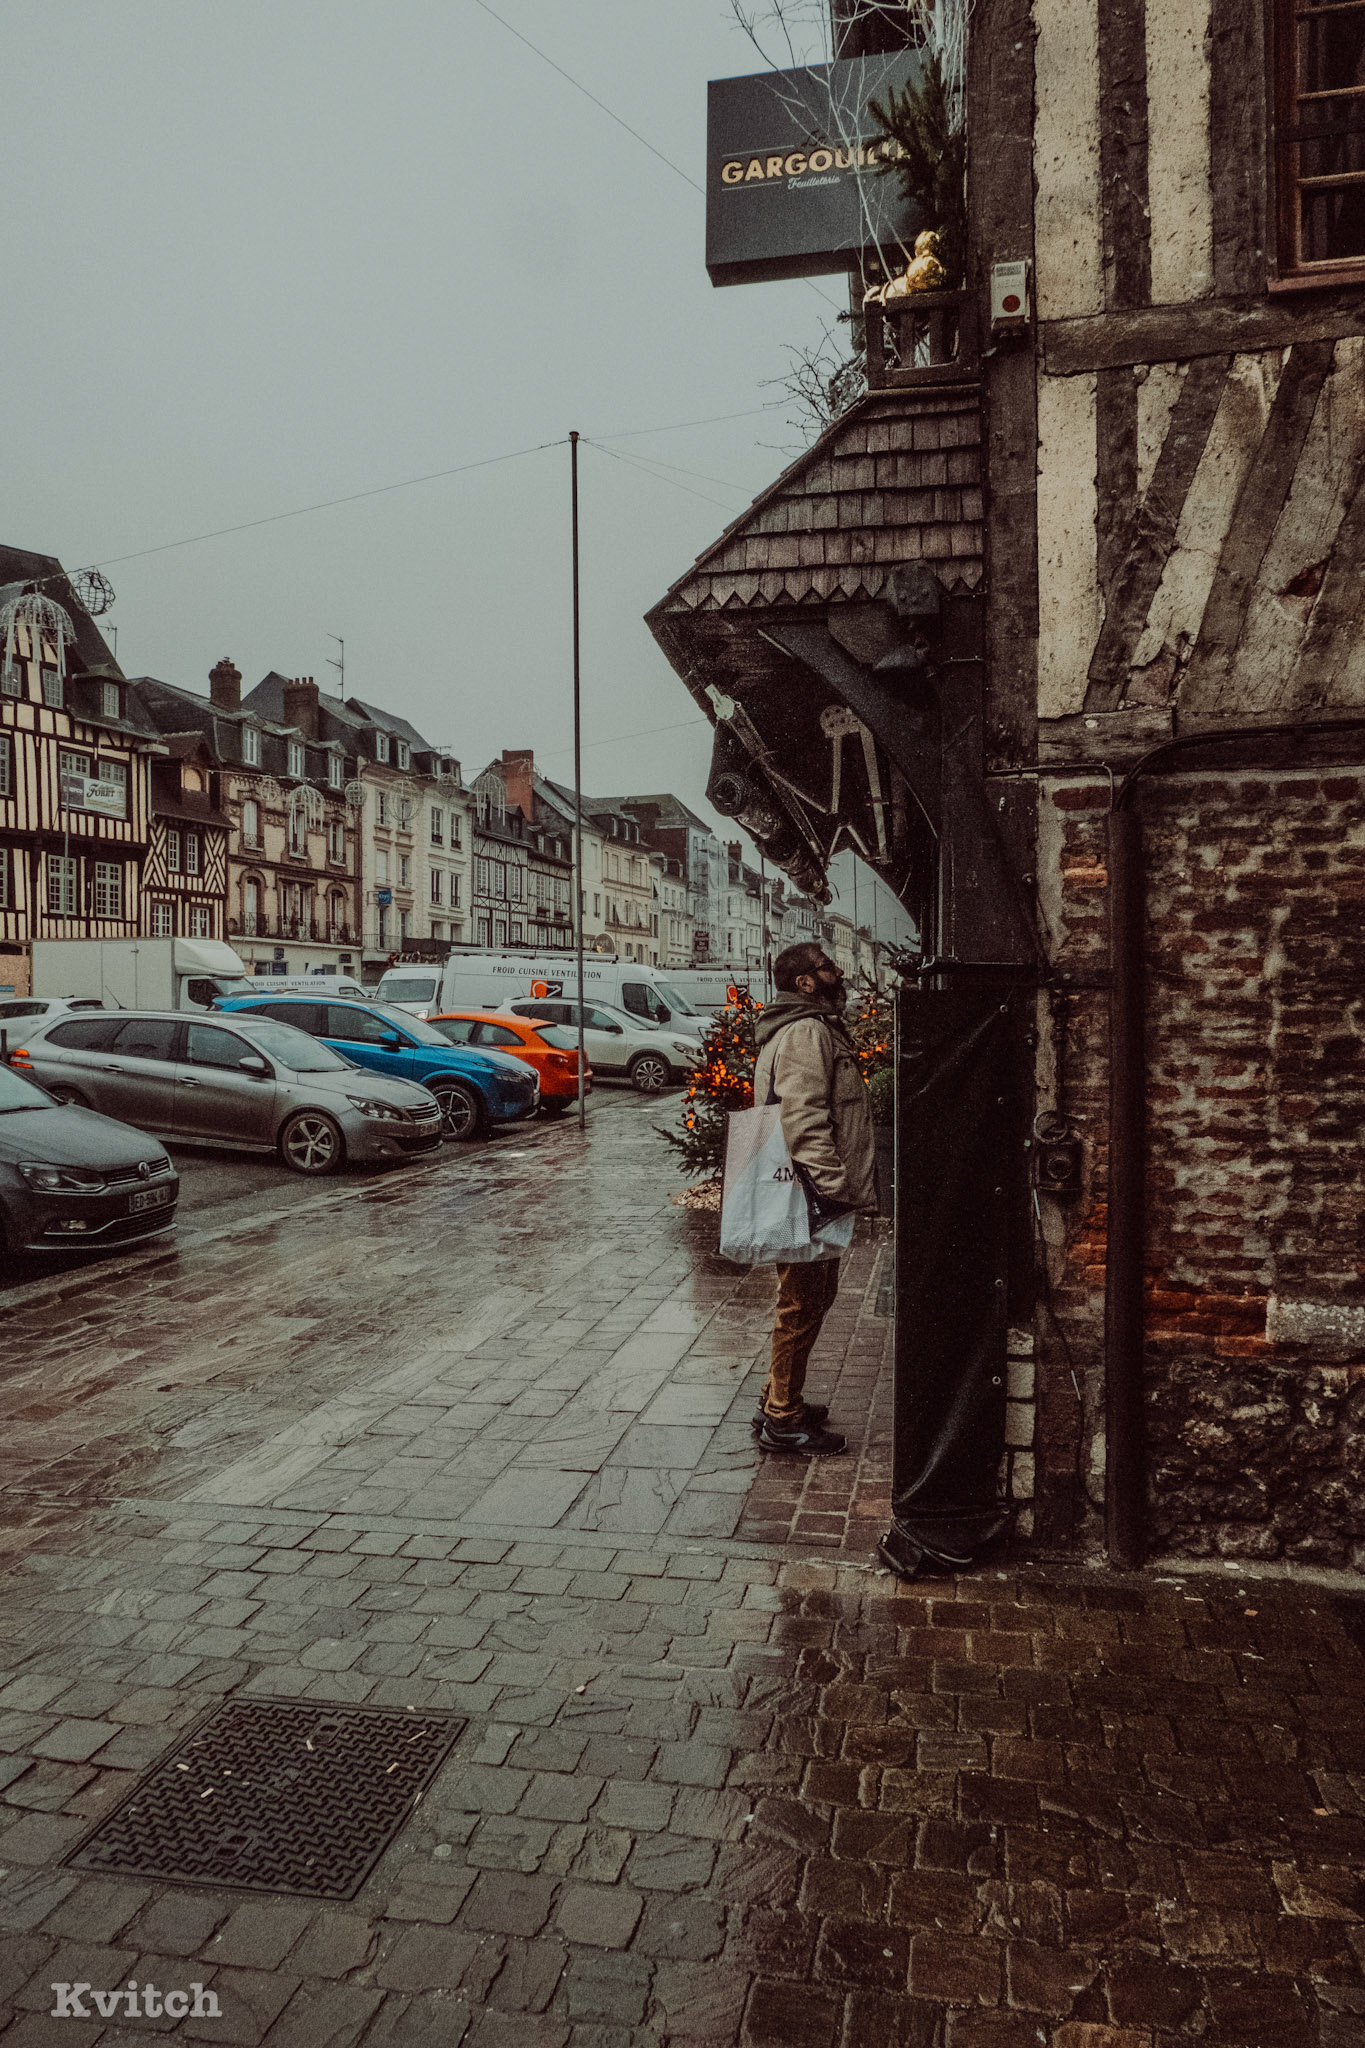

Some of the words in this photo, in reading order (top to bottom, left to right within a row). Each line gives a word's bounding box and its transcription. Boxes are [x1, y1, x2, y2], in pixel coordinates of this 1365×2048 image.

[492, 966, 515, 974] FROID
[518, 967, 548, 976] CUISINE
[551, 969, 602, 979] VENTILTION
